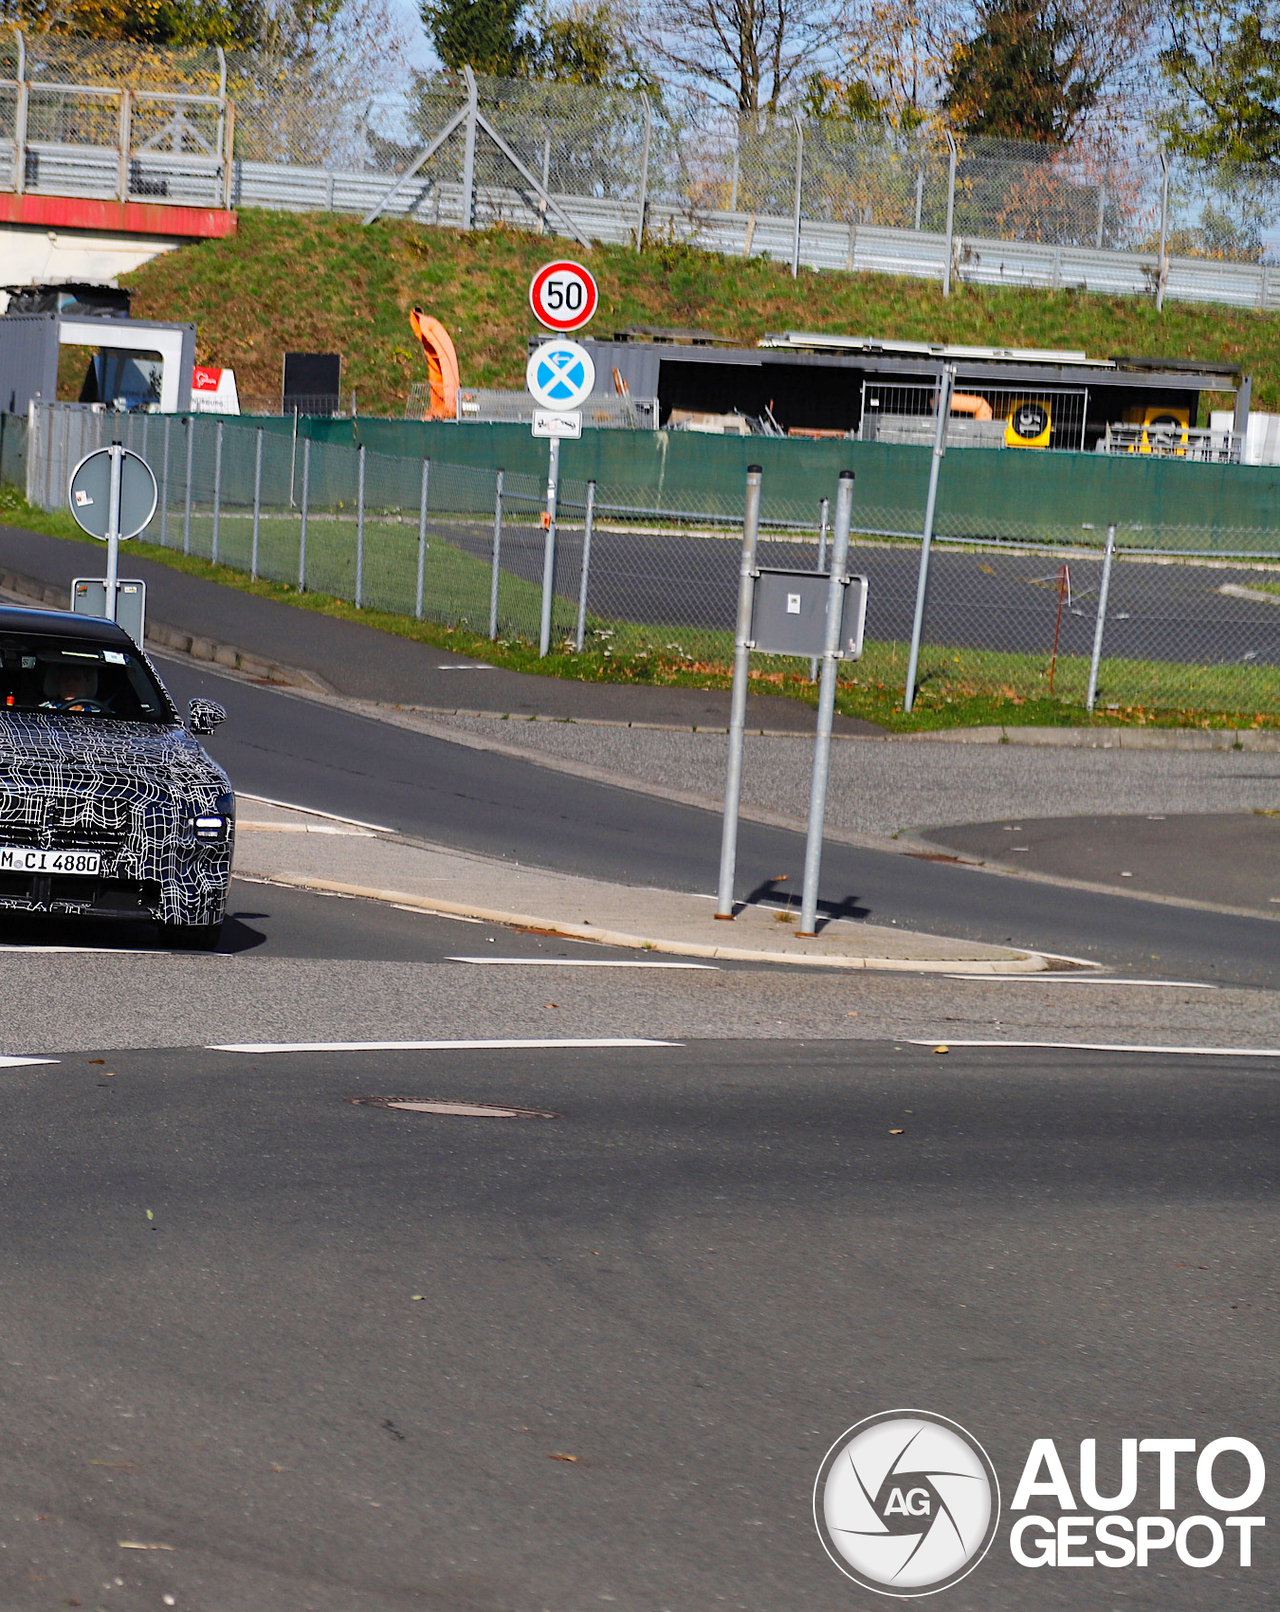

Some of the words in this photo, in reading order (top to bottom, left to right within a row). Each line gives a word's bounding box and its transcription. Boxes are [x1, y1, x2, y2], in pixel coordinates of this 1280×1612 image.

[547, 281, 582, 310] 50
[1, 851, 14, 867] M
[25, 853, 47, 870] CI
[53, 854, 97, 872] 4880
